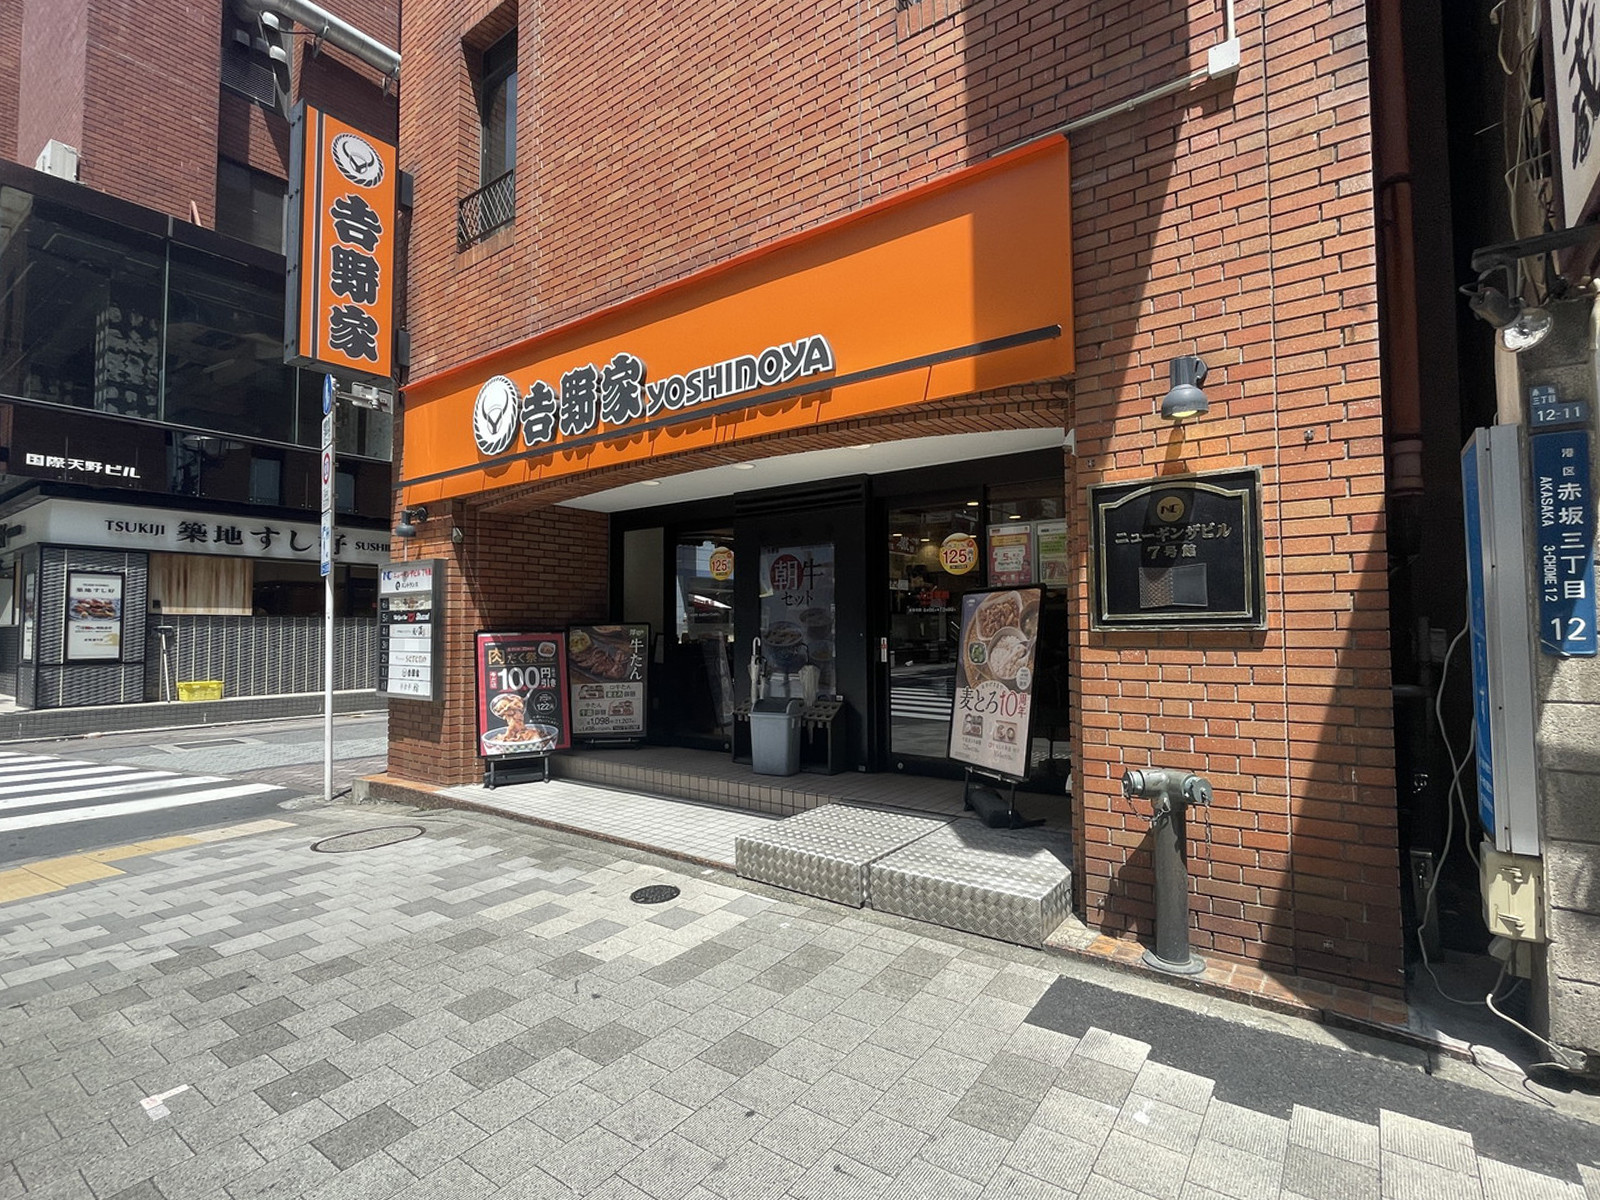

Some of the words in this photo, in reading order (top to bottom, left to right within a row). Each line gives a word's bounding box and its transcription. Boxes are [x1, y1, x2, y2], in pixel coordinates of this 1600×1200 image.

[329, 193, 384, 363] 吉野家
[520, 351, 646, 447] 吉野家
[645, 333, 836, 416] YOSHINOYA
[1537, 406, 1580, 422] 12-11
[25, 452, 141, 479] 国際天野ビル
[1539, 475, 1555, 528] AKASAKA
[105, 520, 165, 537] TSUKIJI
[1557, 481, 1586, 600] 赤坂三丁目
[942, 548, 968, 564] 125
[1543, 544, 1558, 586] 3-CHOME
[773, 557, 825, 591] 朝牛
[781, 590, 814, 607] セット
[1545, 587, 1559, 602] 12
[1550, 616, 1588, 642] 12
[629, 638, 645, 681] 牛たん
